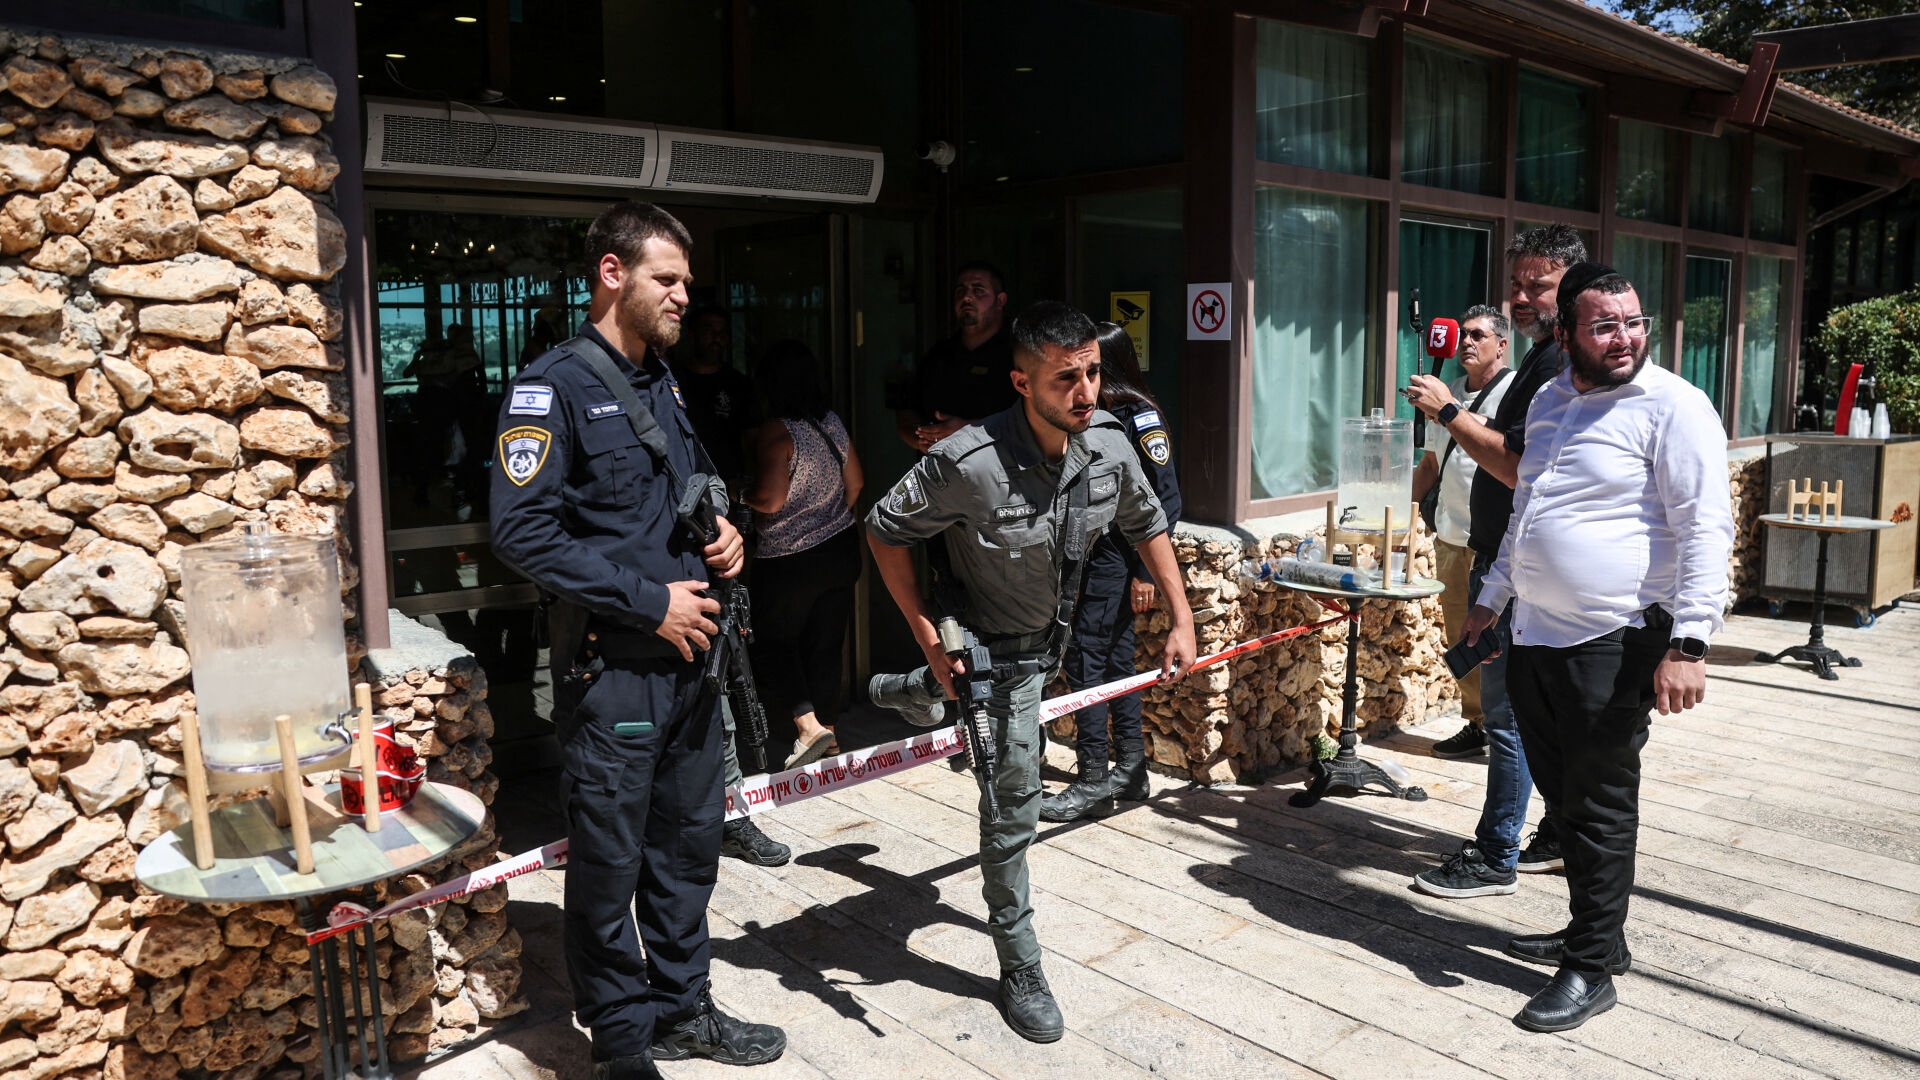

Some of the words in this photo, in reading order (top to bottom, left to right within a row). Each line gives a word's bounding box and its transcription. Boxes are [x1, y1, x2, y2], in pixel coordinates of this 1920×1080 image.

[1430, 329, 1447, 347] 13
[908, 744, 935, 760] מעבר
[934, 738, 947, 754] אין
[867, 750, 902, 772] משטרת
[814, 767, 847, 786] ישראל
[745, 785, 776, 805] מעבר
[776, 780, 791, 801] אין
